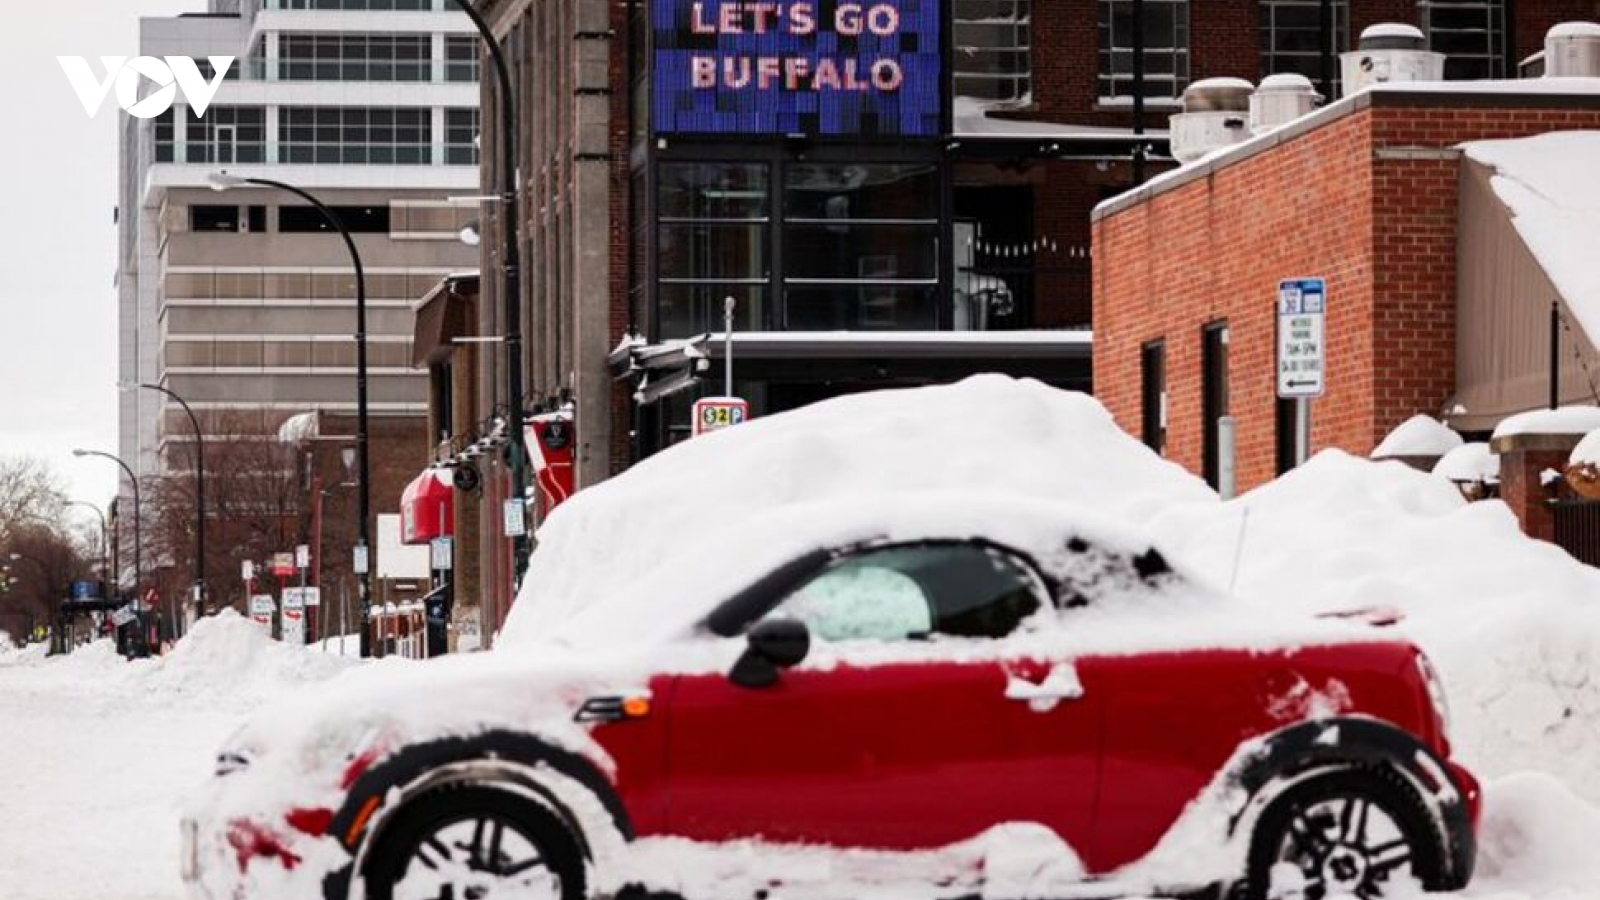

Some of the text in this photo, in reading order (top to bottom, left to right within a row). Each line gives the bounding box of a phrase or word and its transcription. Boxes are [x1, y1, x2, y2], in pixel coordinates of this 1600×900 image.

[691, 1, 900, 35] LET'S GO
[691, 55, 903, 91] BUFFALO
